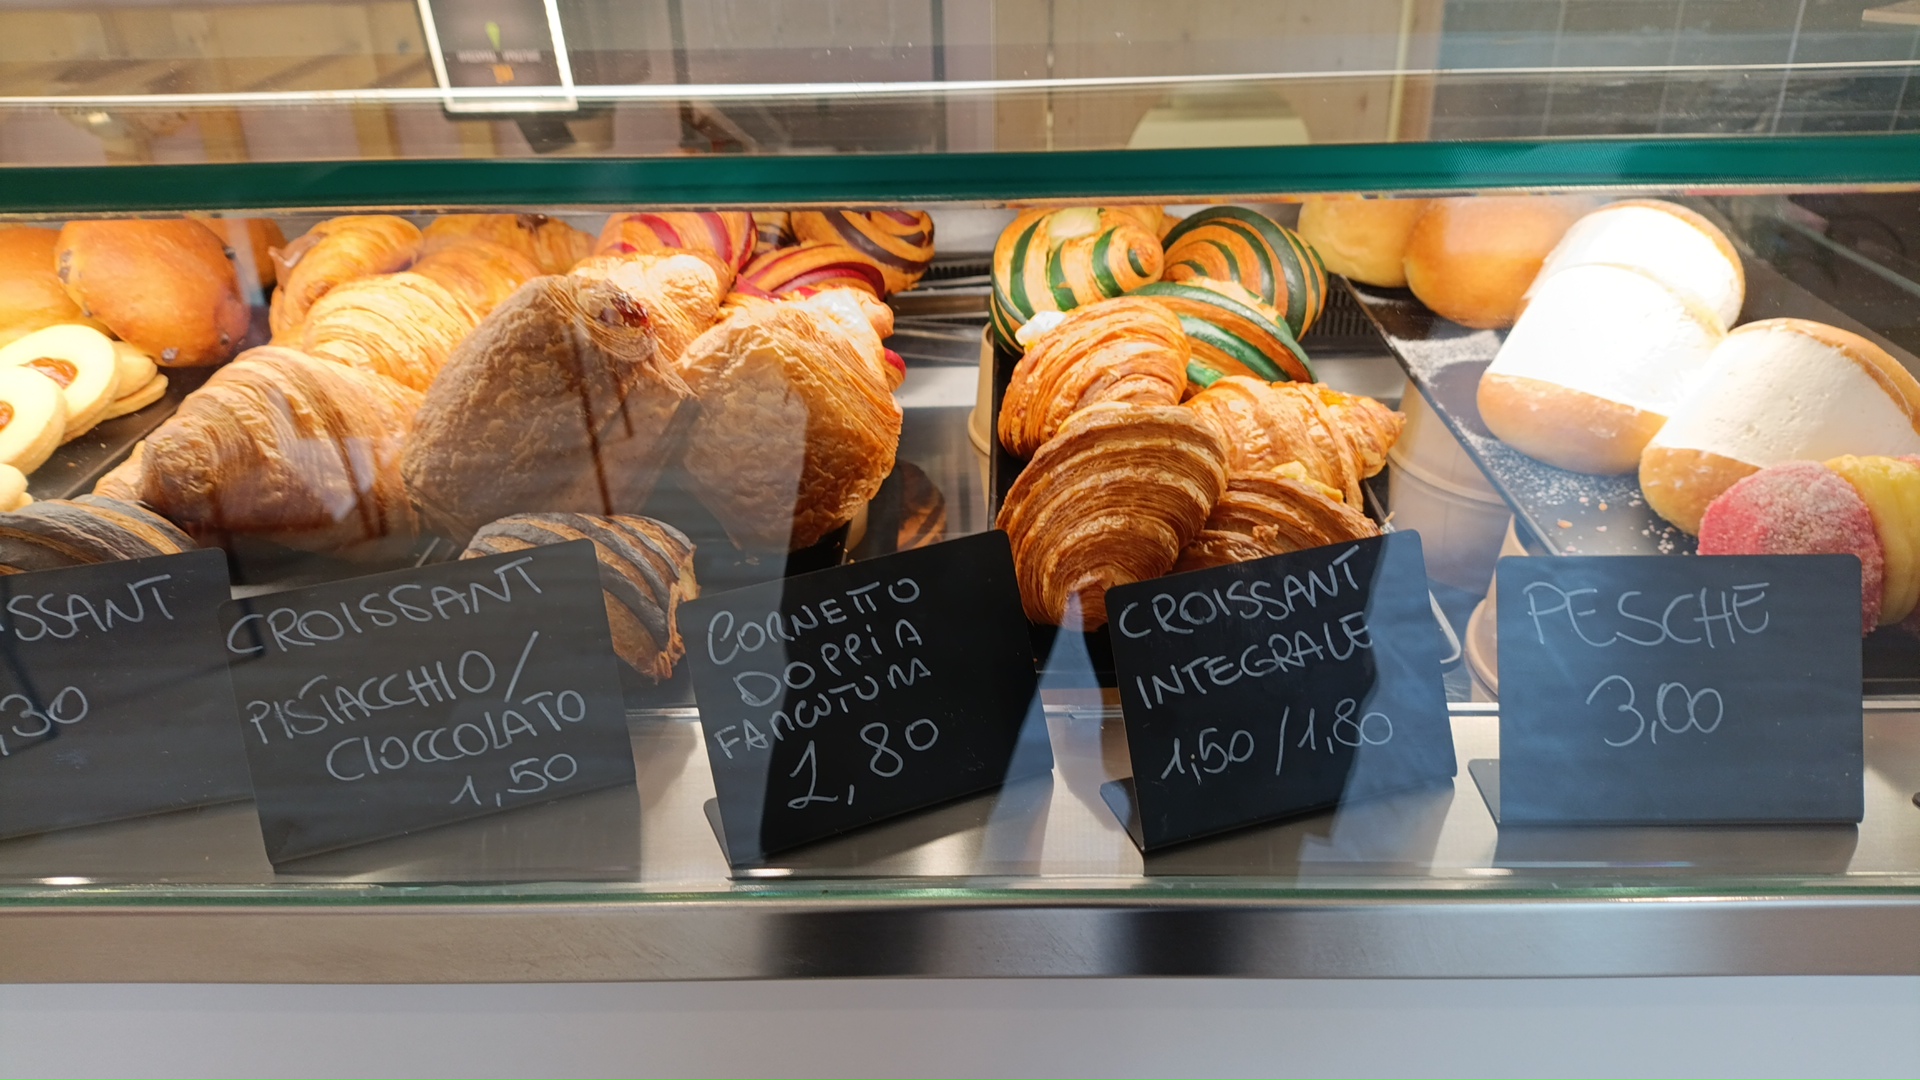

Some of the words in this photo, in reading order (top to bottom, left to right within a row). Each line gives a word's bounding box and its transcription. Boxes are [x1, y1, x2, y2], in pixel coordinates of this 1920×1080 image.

[0, 573, 174, 641] SSANT
[226, 556, 543, 654] CROISSANT
[707, 577, 921, 665] CORNETTO
[1118, 544, 1360, 639] CROISSANT
[1522, 581, 1771, 648] PESCHE
[1136, 611, 1373, 710] INTEGRALE
[326, 690, 586, 781] CIOCCOLATO
[1585, 674, 1724, 747] 3,00
[450, 753, 578, 807] 1,50
[787, 718, 939, 809] 1,80
[1160, 727, 1255, 785] 1,50
